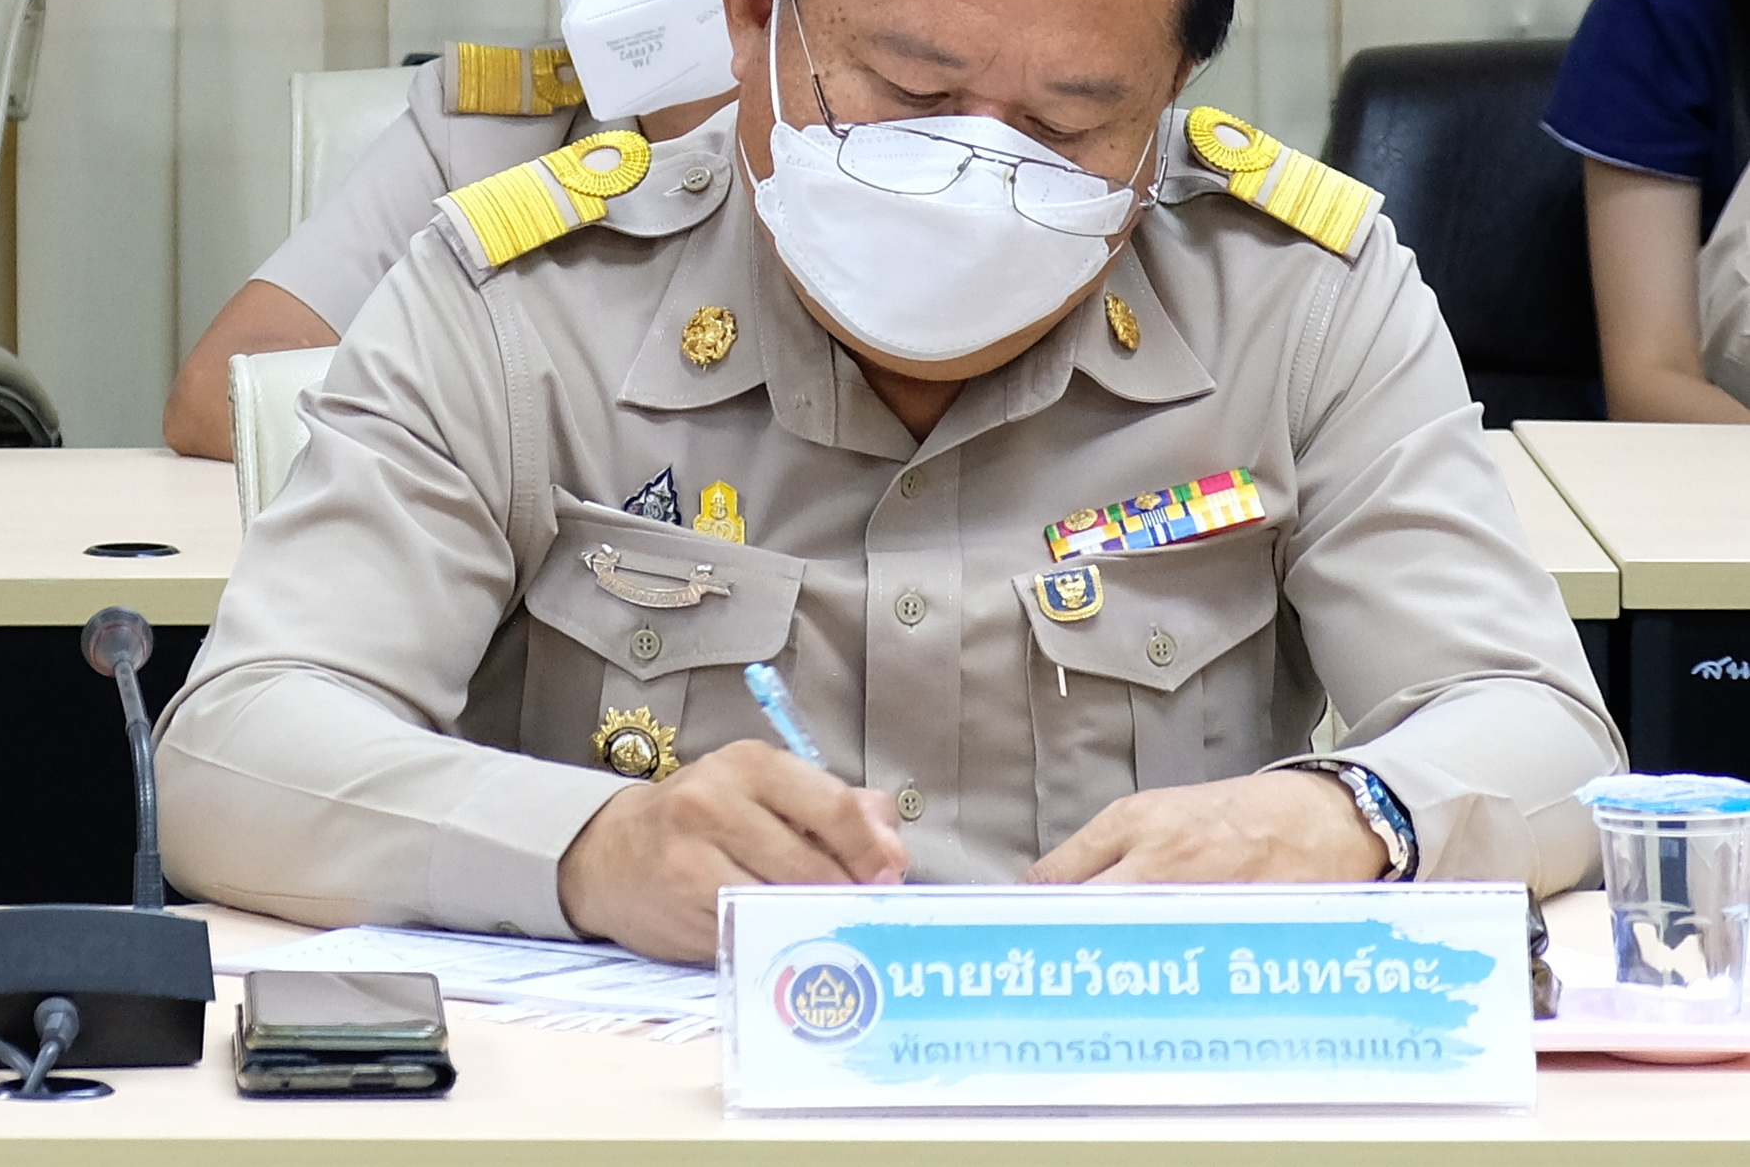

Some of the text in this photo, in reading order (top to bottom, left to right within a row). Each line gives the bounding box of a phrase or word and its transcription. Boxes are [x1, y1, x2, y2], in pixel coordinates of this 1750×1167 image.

[886, 944, 1440, 998] นายชัยวัฒน์ อินทร์ตะ
[888, 1028, 1444, 1069] พัฒนาการอำเภอลาดหลุมแก้ว
